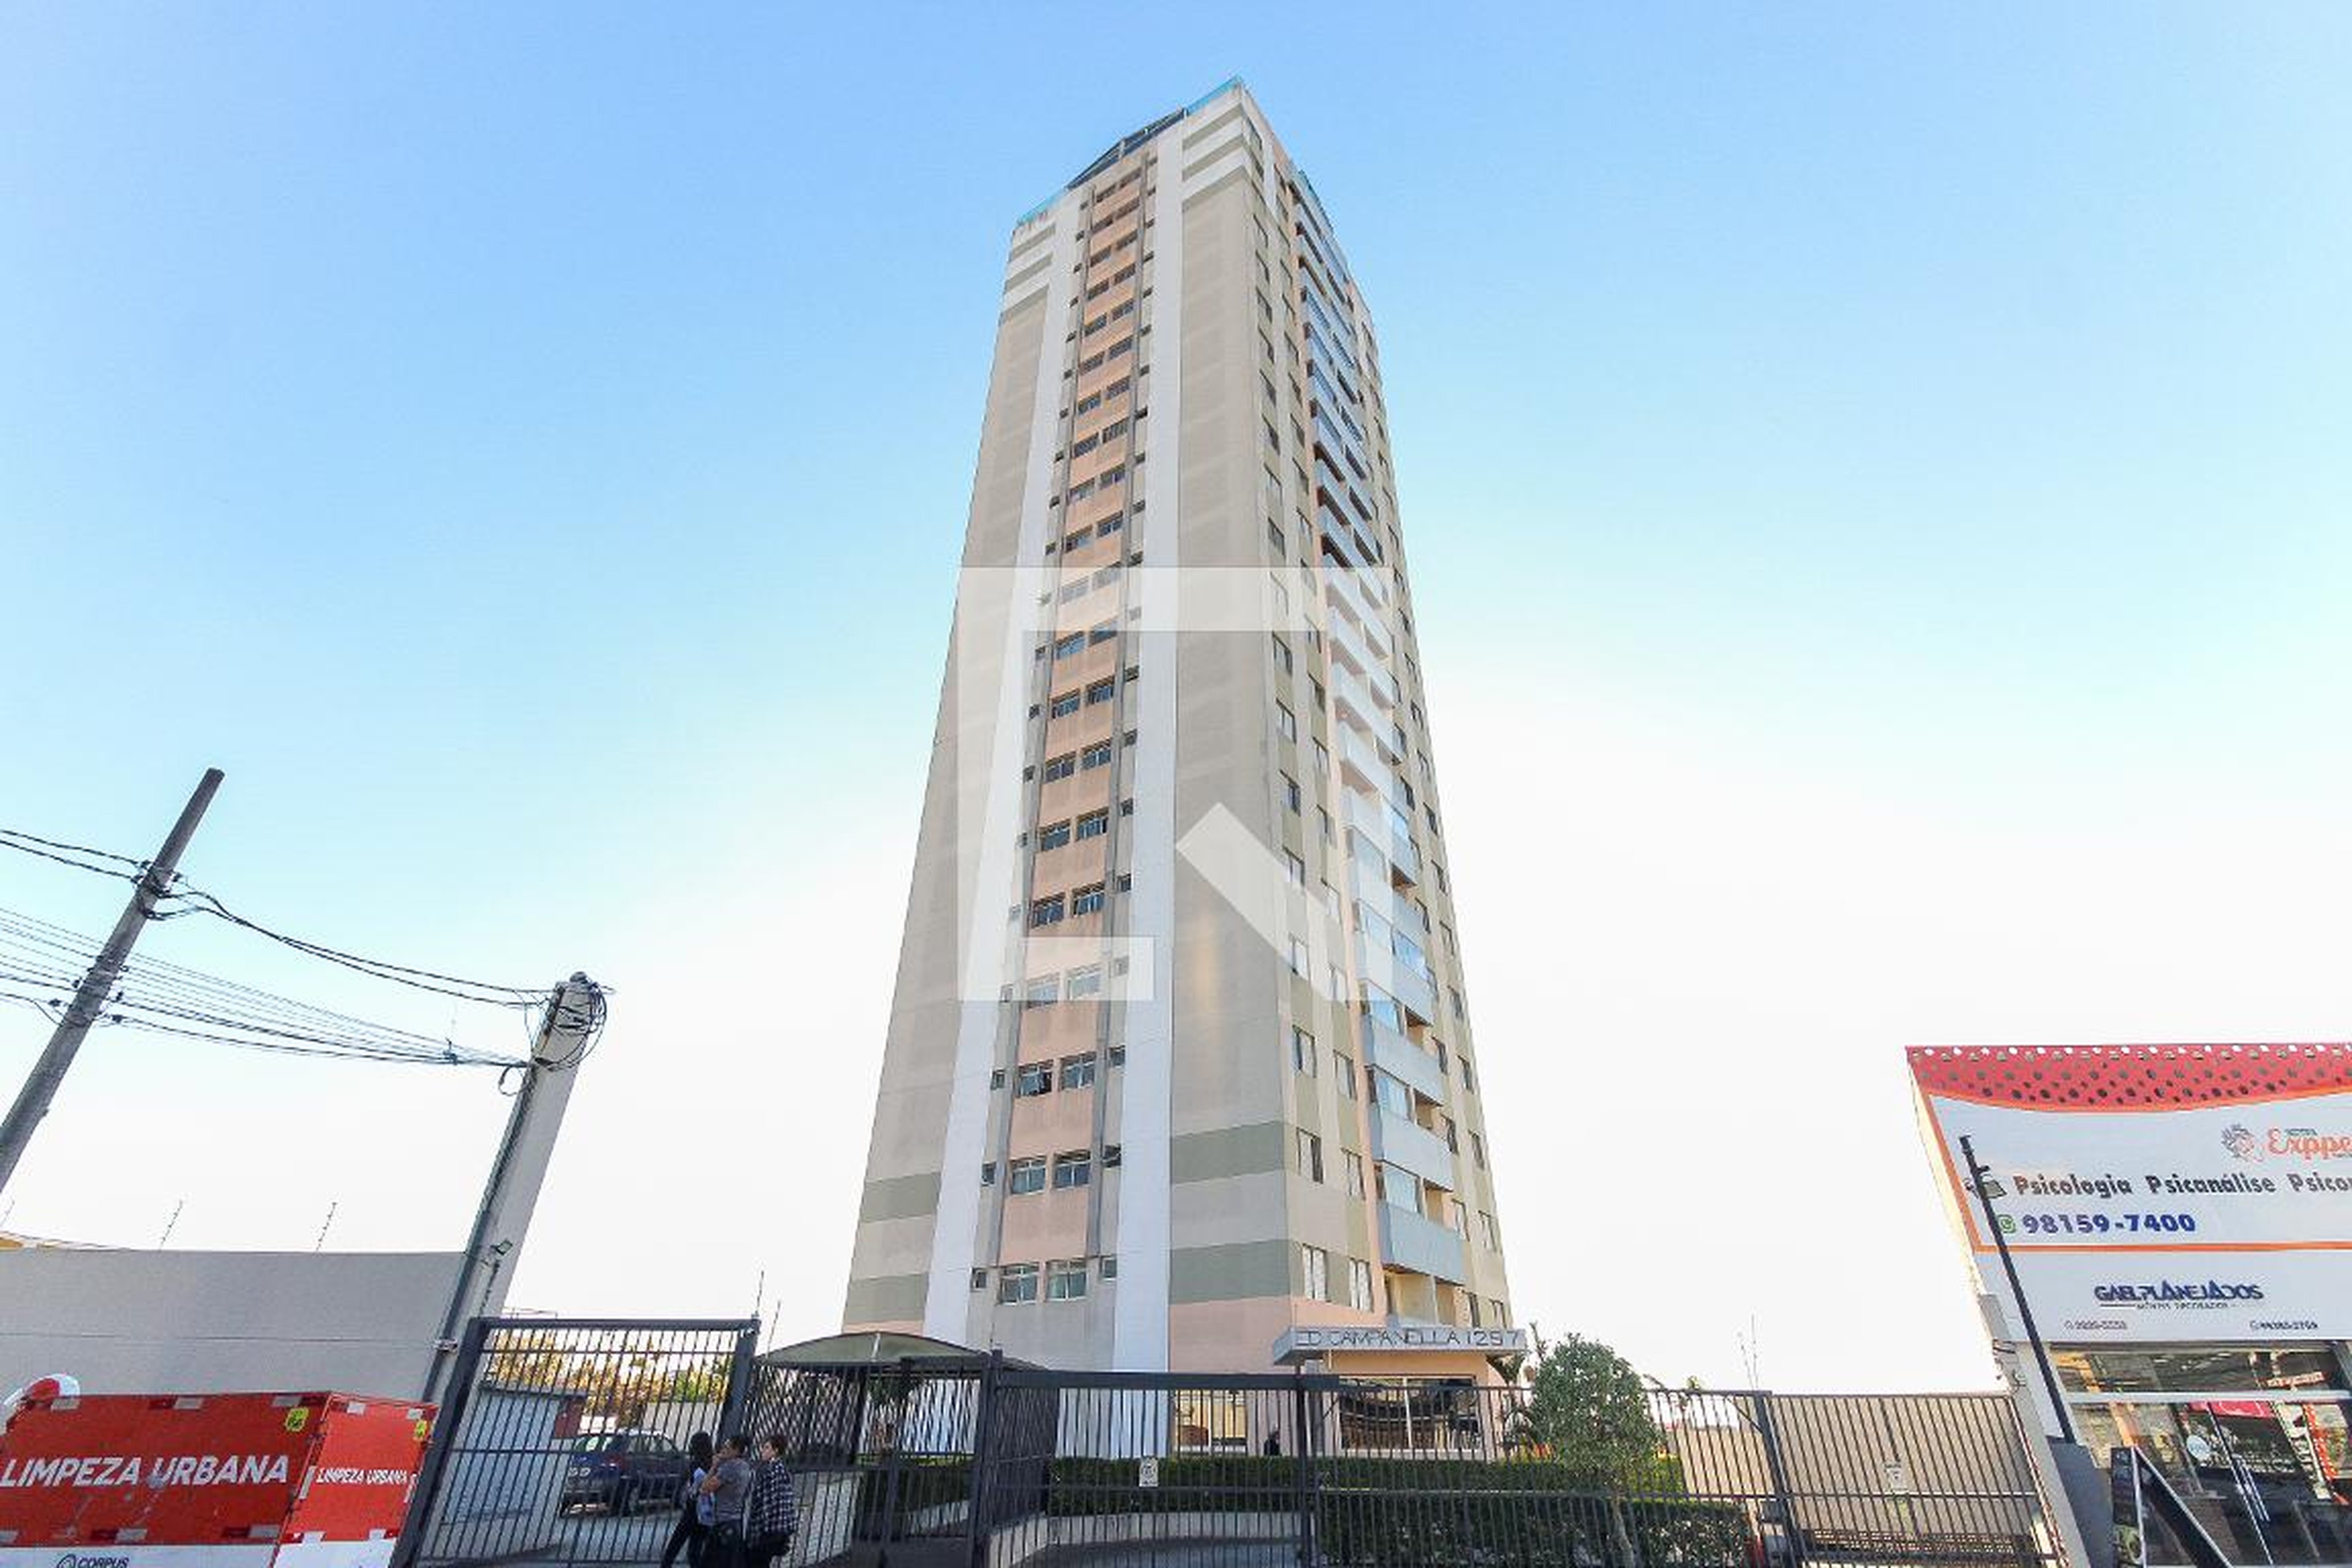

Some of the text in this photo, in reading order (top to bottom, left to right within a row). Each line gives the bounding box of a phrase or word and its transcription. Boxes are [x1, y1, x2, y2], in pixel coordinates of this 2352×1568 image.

[2013, 1174, 2132, 1198] Psicologia
[2145, 1172, 2276, 1193] Psicanálise
[2022, 1214, 2196, 1234] 98159-7400
[1330, 1329, 1460, 1346] CAMPANELLA
[0, 1455, 288, 1487] LIMPEZA URBANA
[316, 1468, 364, 1483] LIMPEZA
